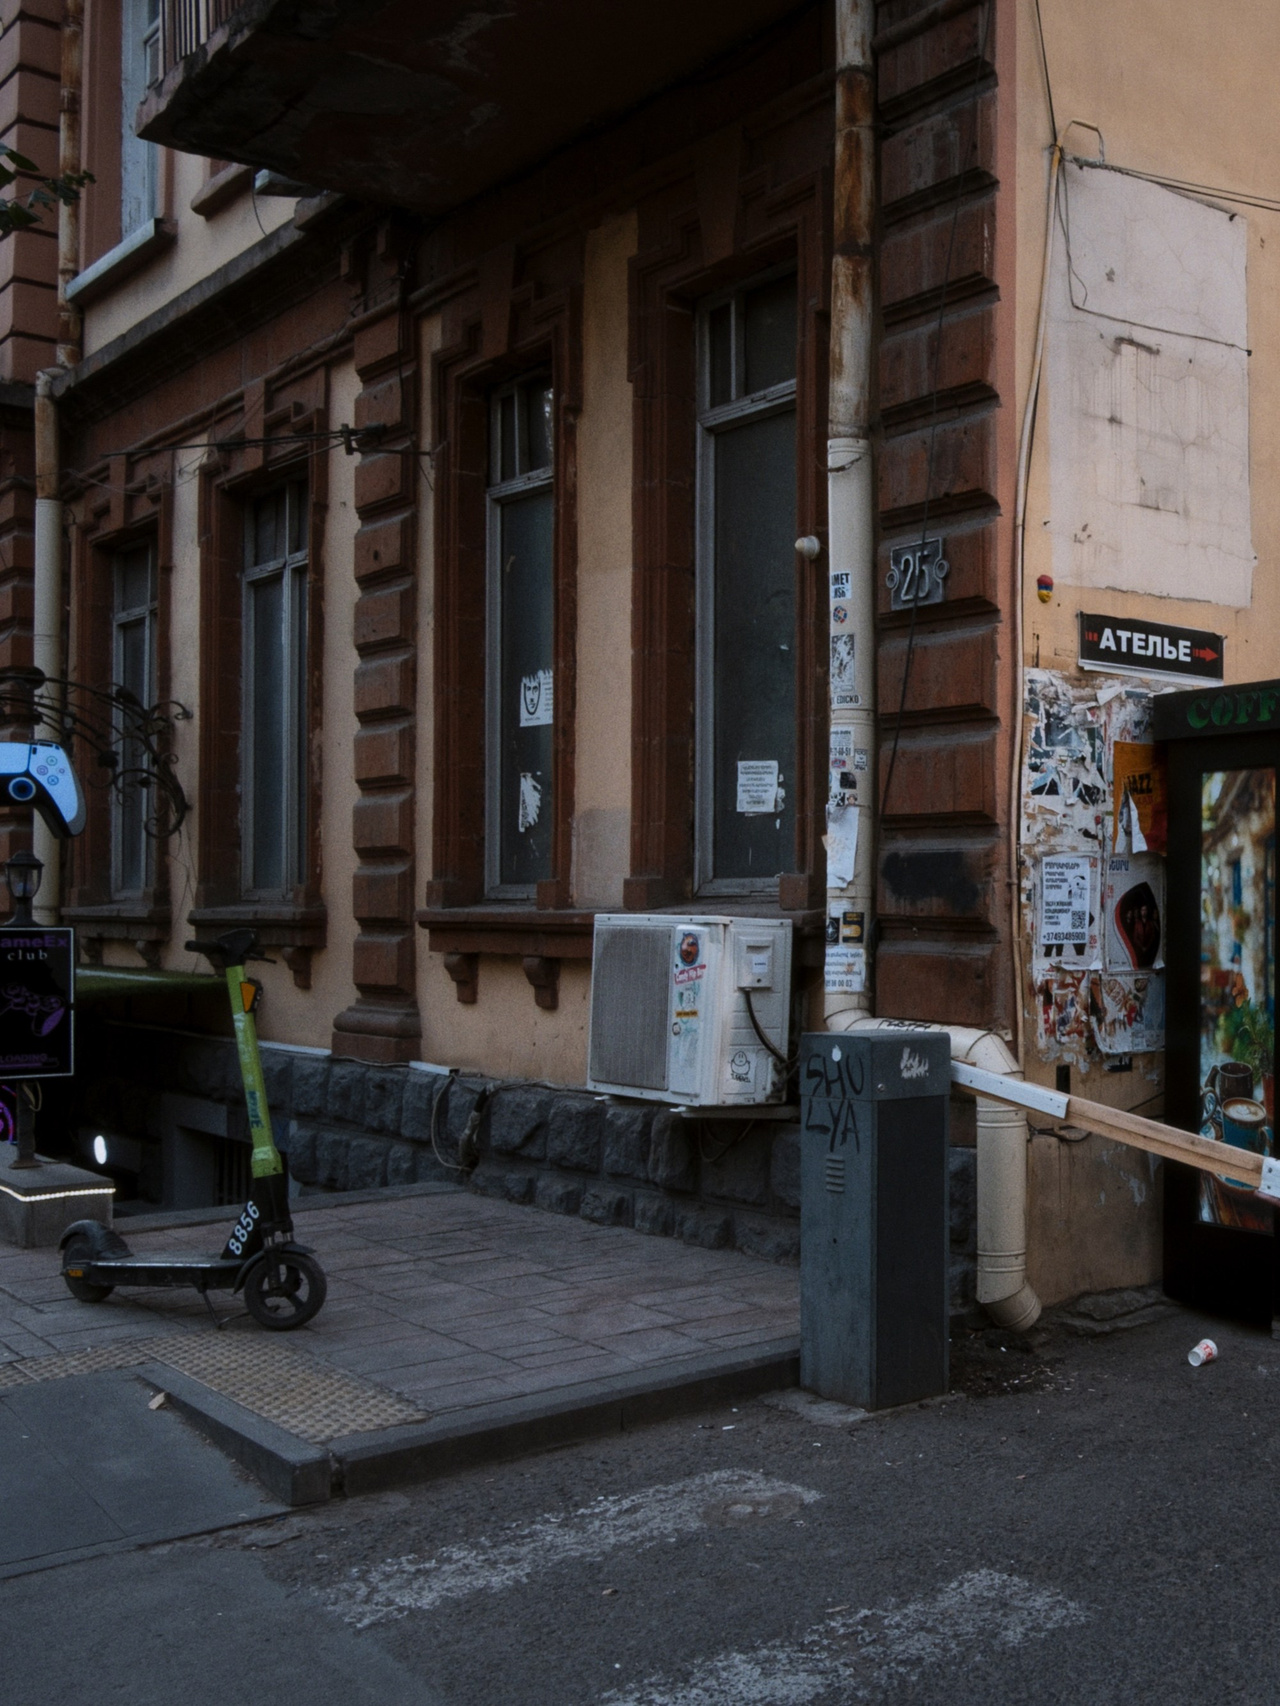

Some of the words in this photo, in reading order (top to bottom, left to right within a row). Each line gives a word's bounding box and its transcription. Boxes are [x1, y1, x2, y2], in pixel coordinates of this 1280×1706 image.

[901, 551, 929, 601] 25
[1099, 627, 1192, 663] АТЕЛЬЕ
[0, 935, 68, 948] ameEx
[7, 949, 48, 961] club
[229, 1200, 260, 1256] 8856
